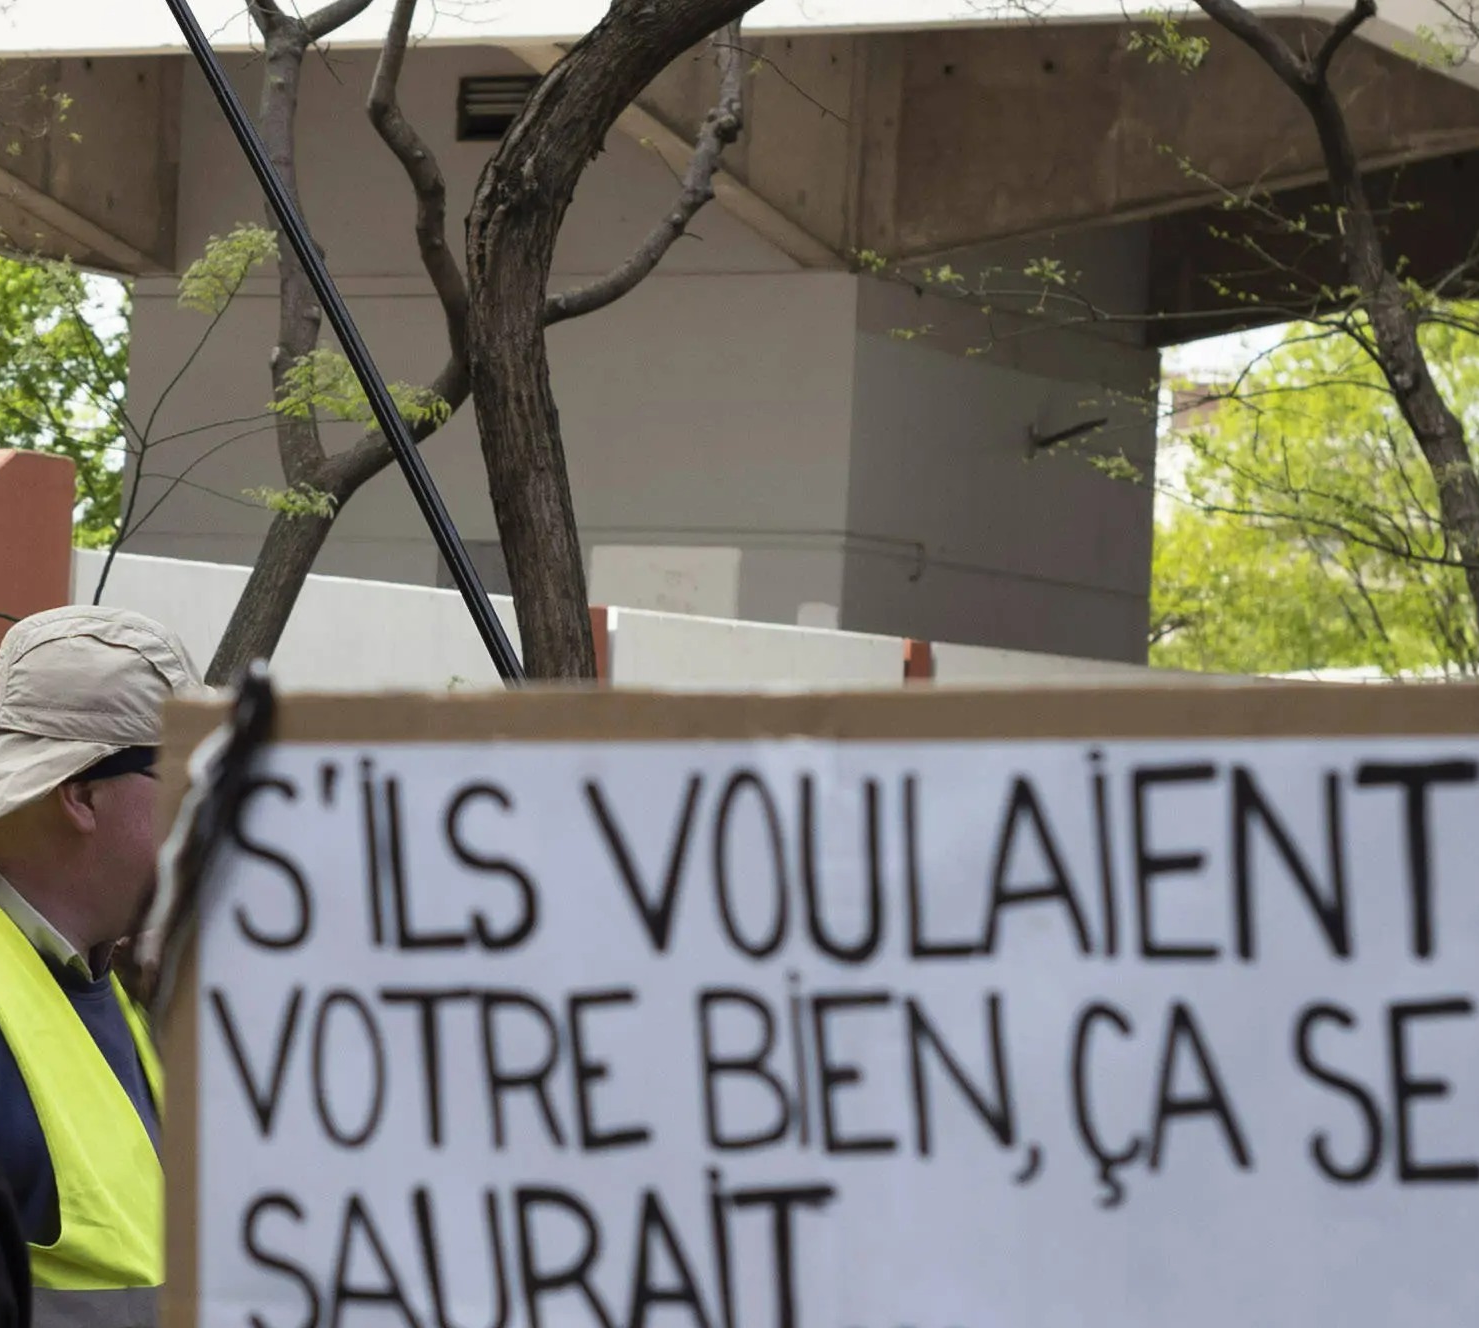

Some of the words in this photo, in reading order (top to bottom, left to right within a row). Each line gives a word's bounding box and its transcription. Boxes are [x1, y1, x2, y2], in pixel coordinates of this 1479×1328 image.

[229, 756, 538, 953] S'ILS
[209, 987, 651, 1152] VOTRE
[1071, 1002, 1251, 1207] ÇA
